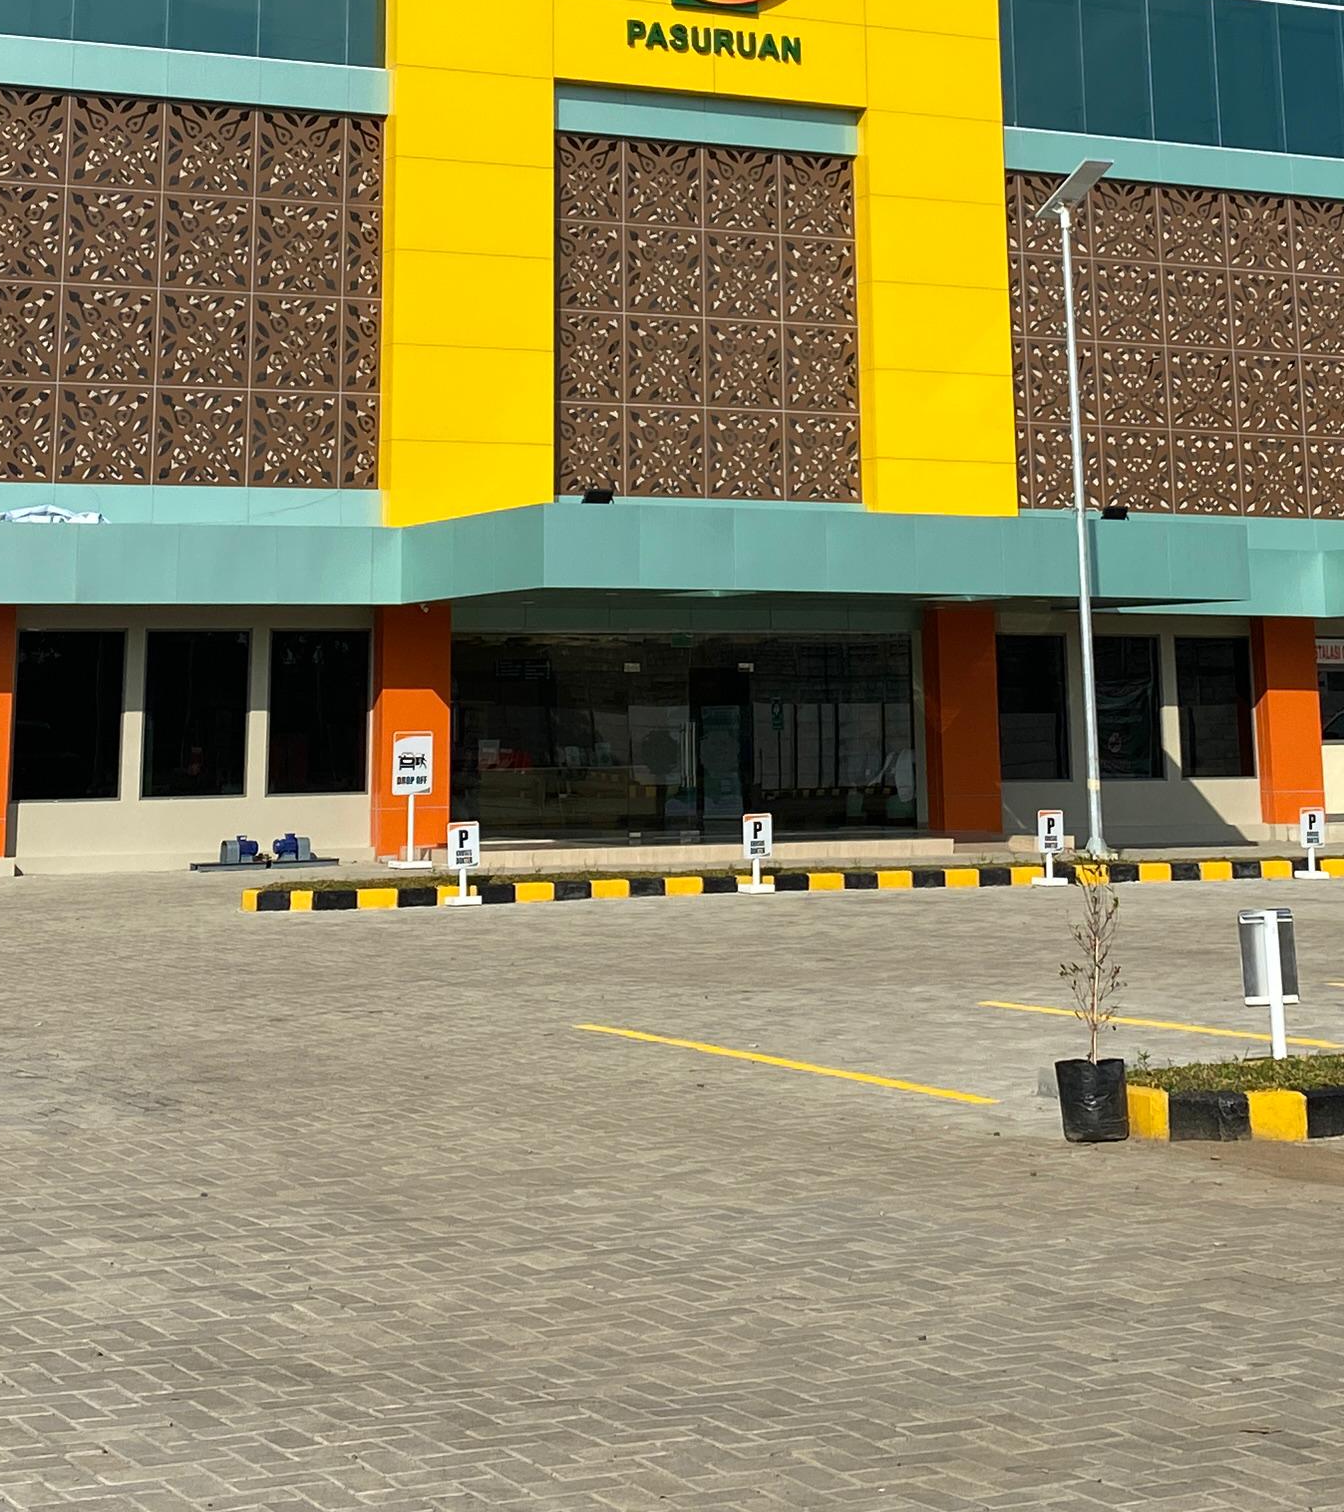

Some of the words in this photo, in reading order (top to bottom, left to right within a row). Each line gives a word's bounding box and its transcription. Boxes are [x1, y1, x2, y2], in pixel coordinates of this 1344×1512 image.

[627, 19, 801, 65] PASURUAN
[753, 821, 762, 839] P
[1047, 817, 1055, 834] P
[1308, 813, 1316, 830] P
[458, 829, 469, 849] P
